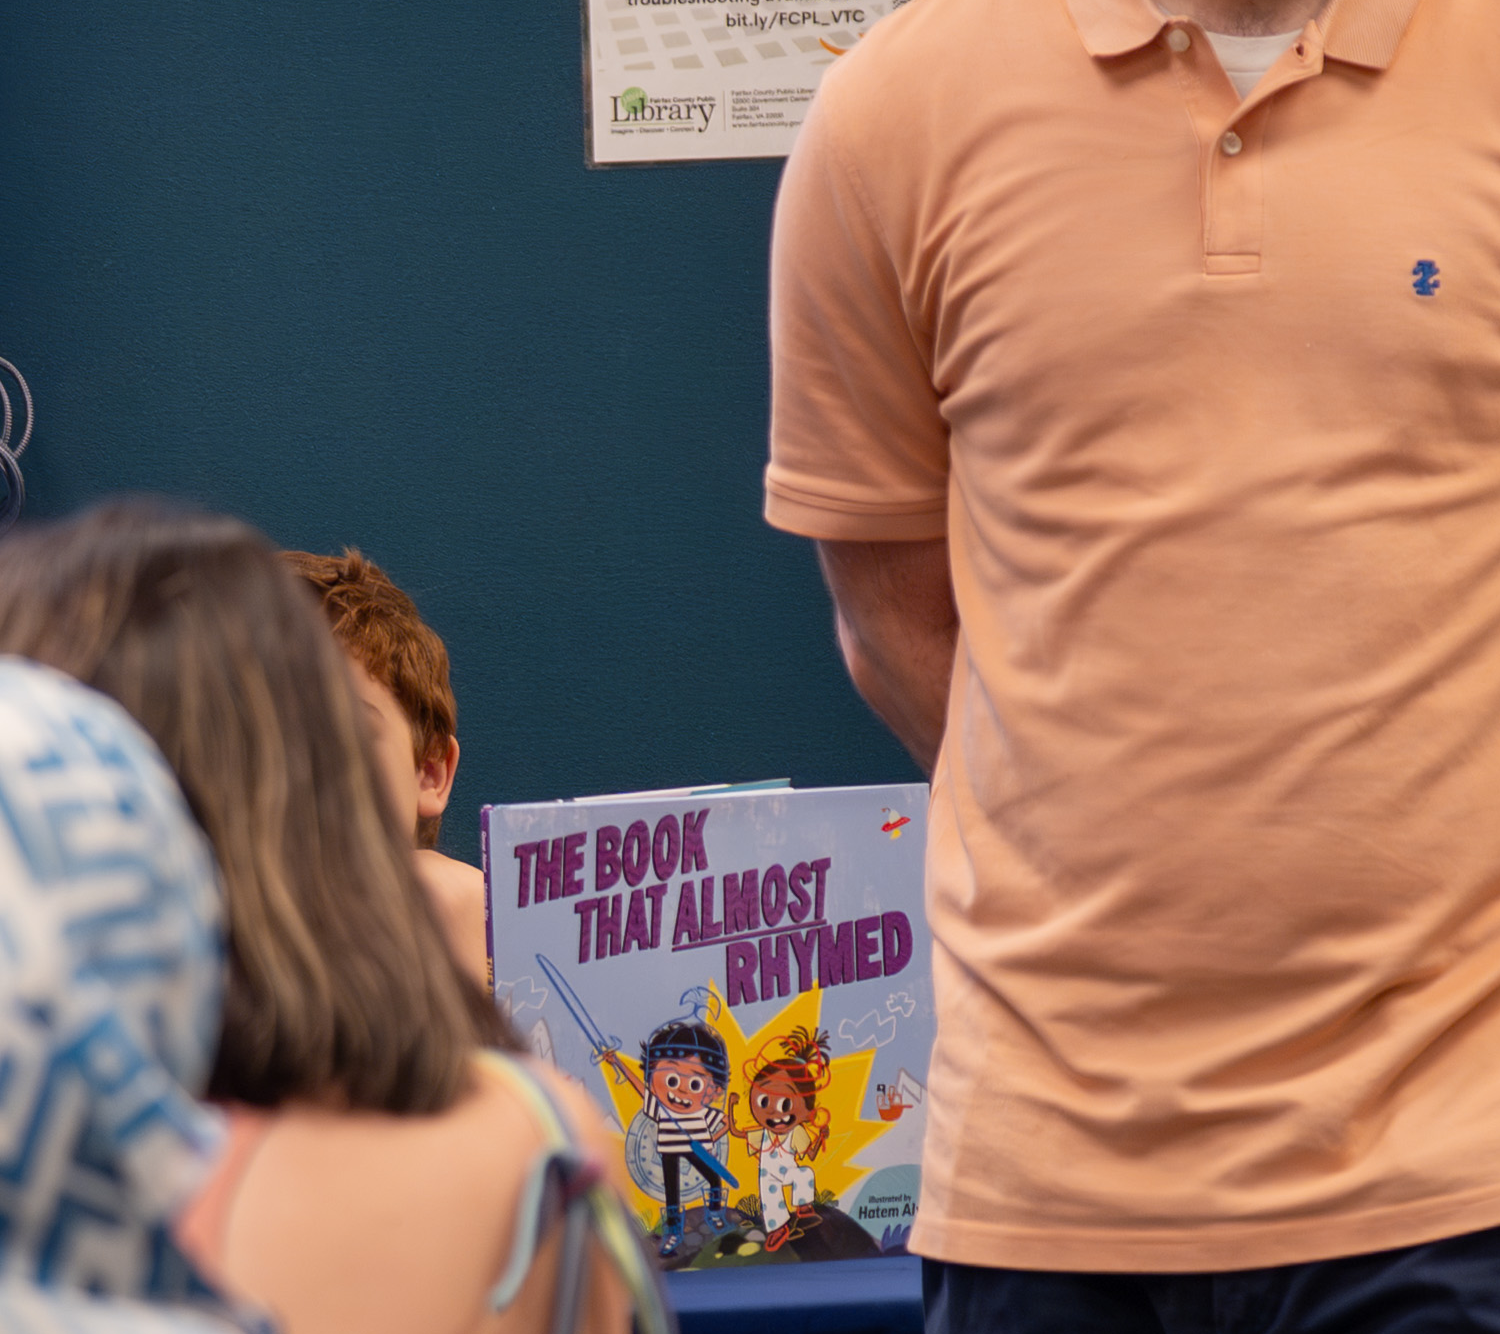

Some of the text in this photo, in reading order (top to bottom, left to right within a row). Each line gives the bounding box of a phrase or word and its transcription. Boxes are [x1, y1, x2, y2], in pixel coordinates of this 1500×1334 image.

[610, 96, 717, 134] Library
[514, 832, 588, 909] THE
[596, 807, 711, 892] BOOK
[575, 857, 832, 965] THAT ALMOST
[725, 911, 915, 1008] RHYMED
[859, 1204, 919, 1220] Hatem Al
[868, 1193, 912, 1204] illustrated
